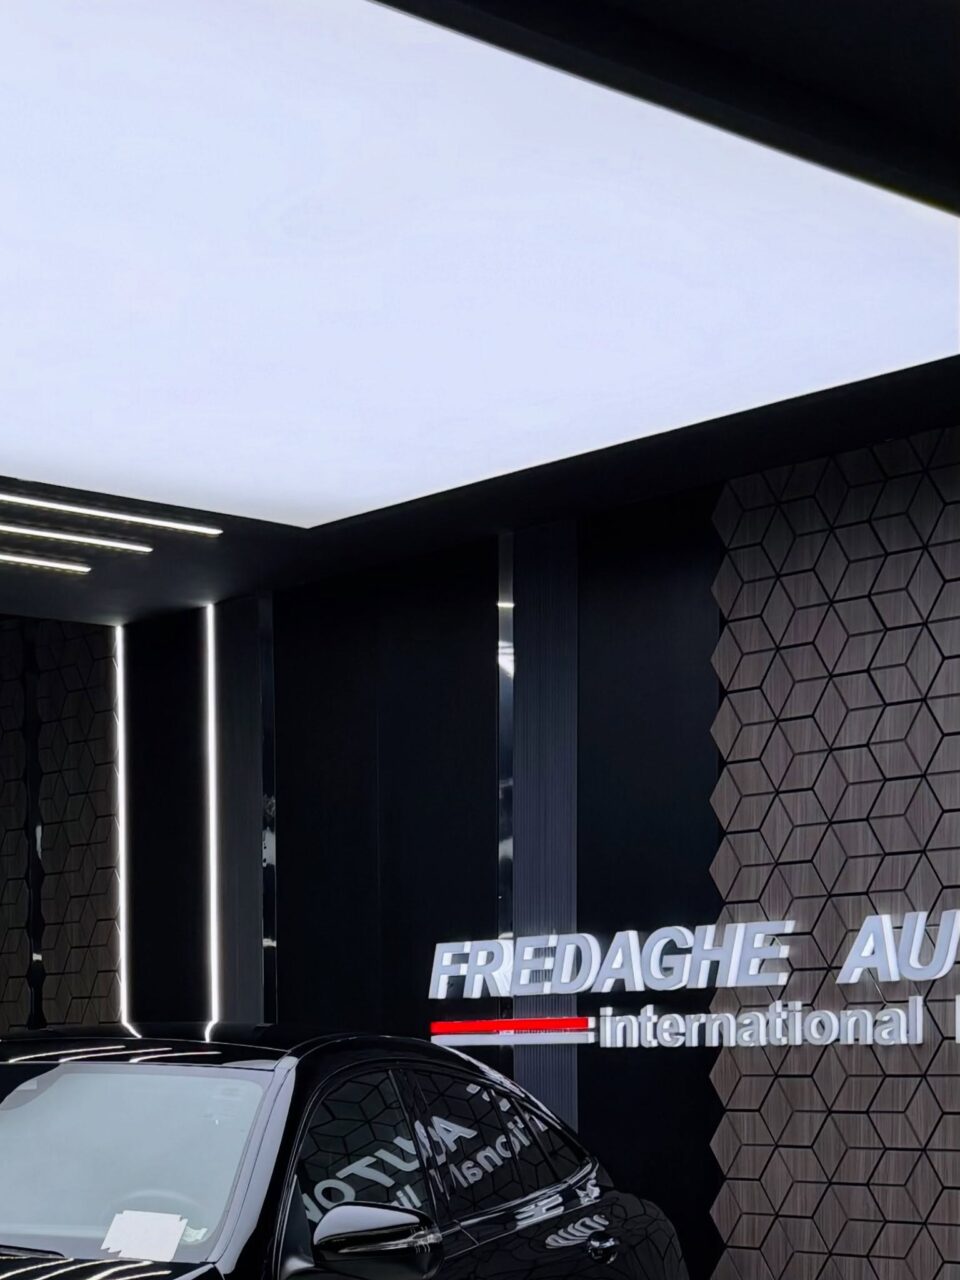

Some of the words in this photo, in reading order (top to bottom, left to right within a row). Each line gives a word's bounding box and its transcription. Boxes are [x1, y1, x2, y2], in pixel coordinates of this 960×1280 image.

[428, 919, 797, 1000] FREDAGHE
[835, 908, 960, 985] AU
[599, 995, 924, 1048] international
